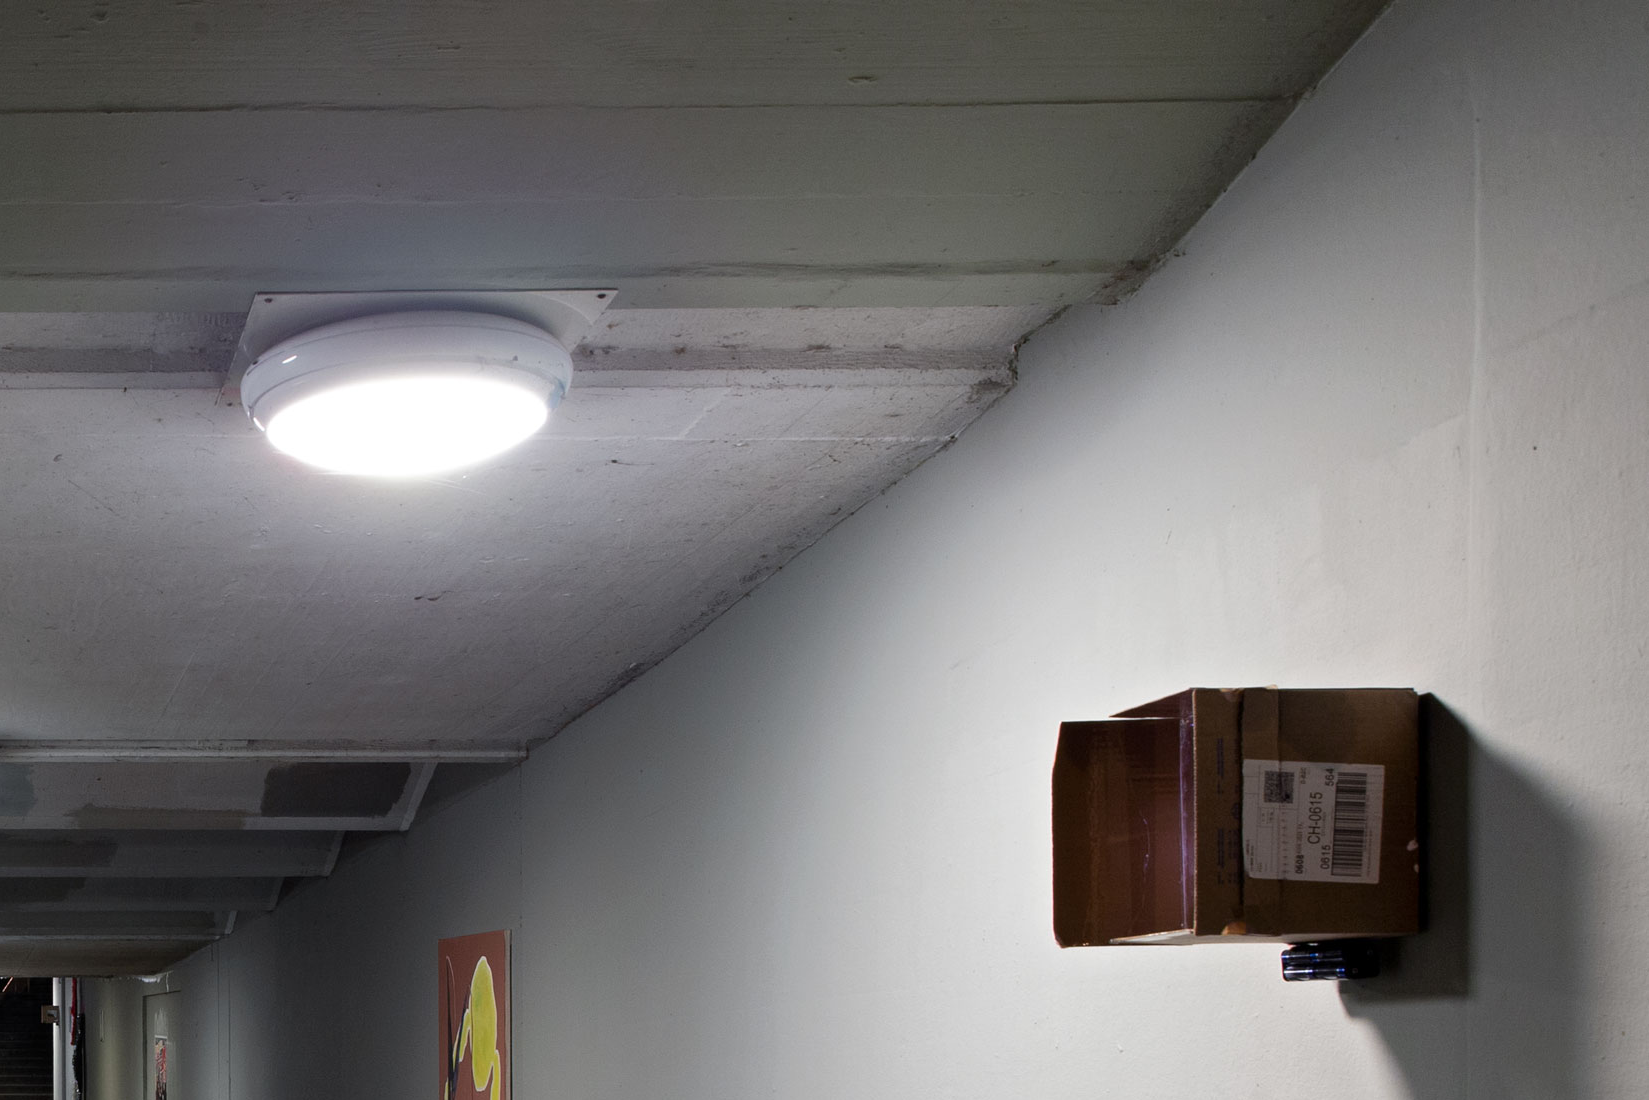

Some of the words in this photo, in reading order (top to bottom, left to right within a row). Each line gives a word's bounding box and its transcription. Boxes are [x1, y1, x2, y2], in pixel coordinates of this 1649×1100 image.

[1324, 768, 1335, 786] 564
[1307, 792, 1323, 844] CH-0615
[1320, 845, 1331, 869] 0615
